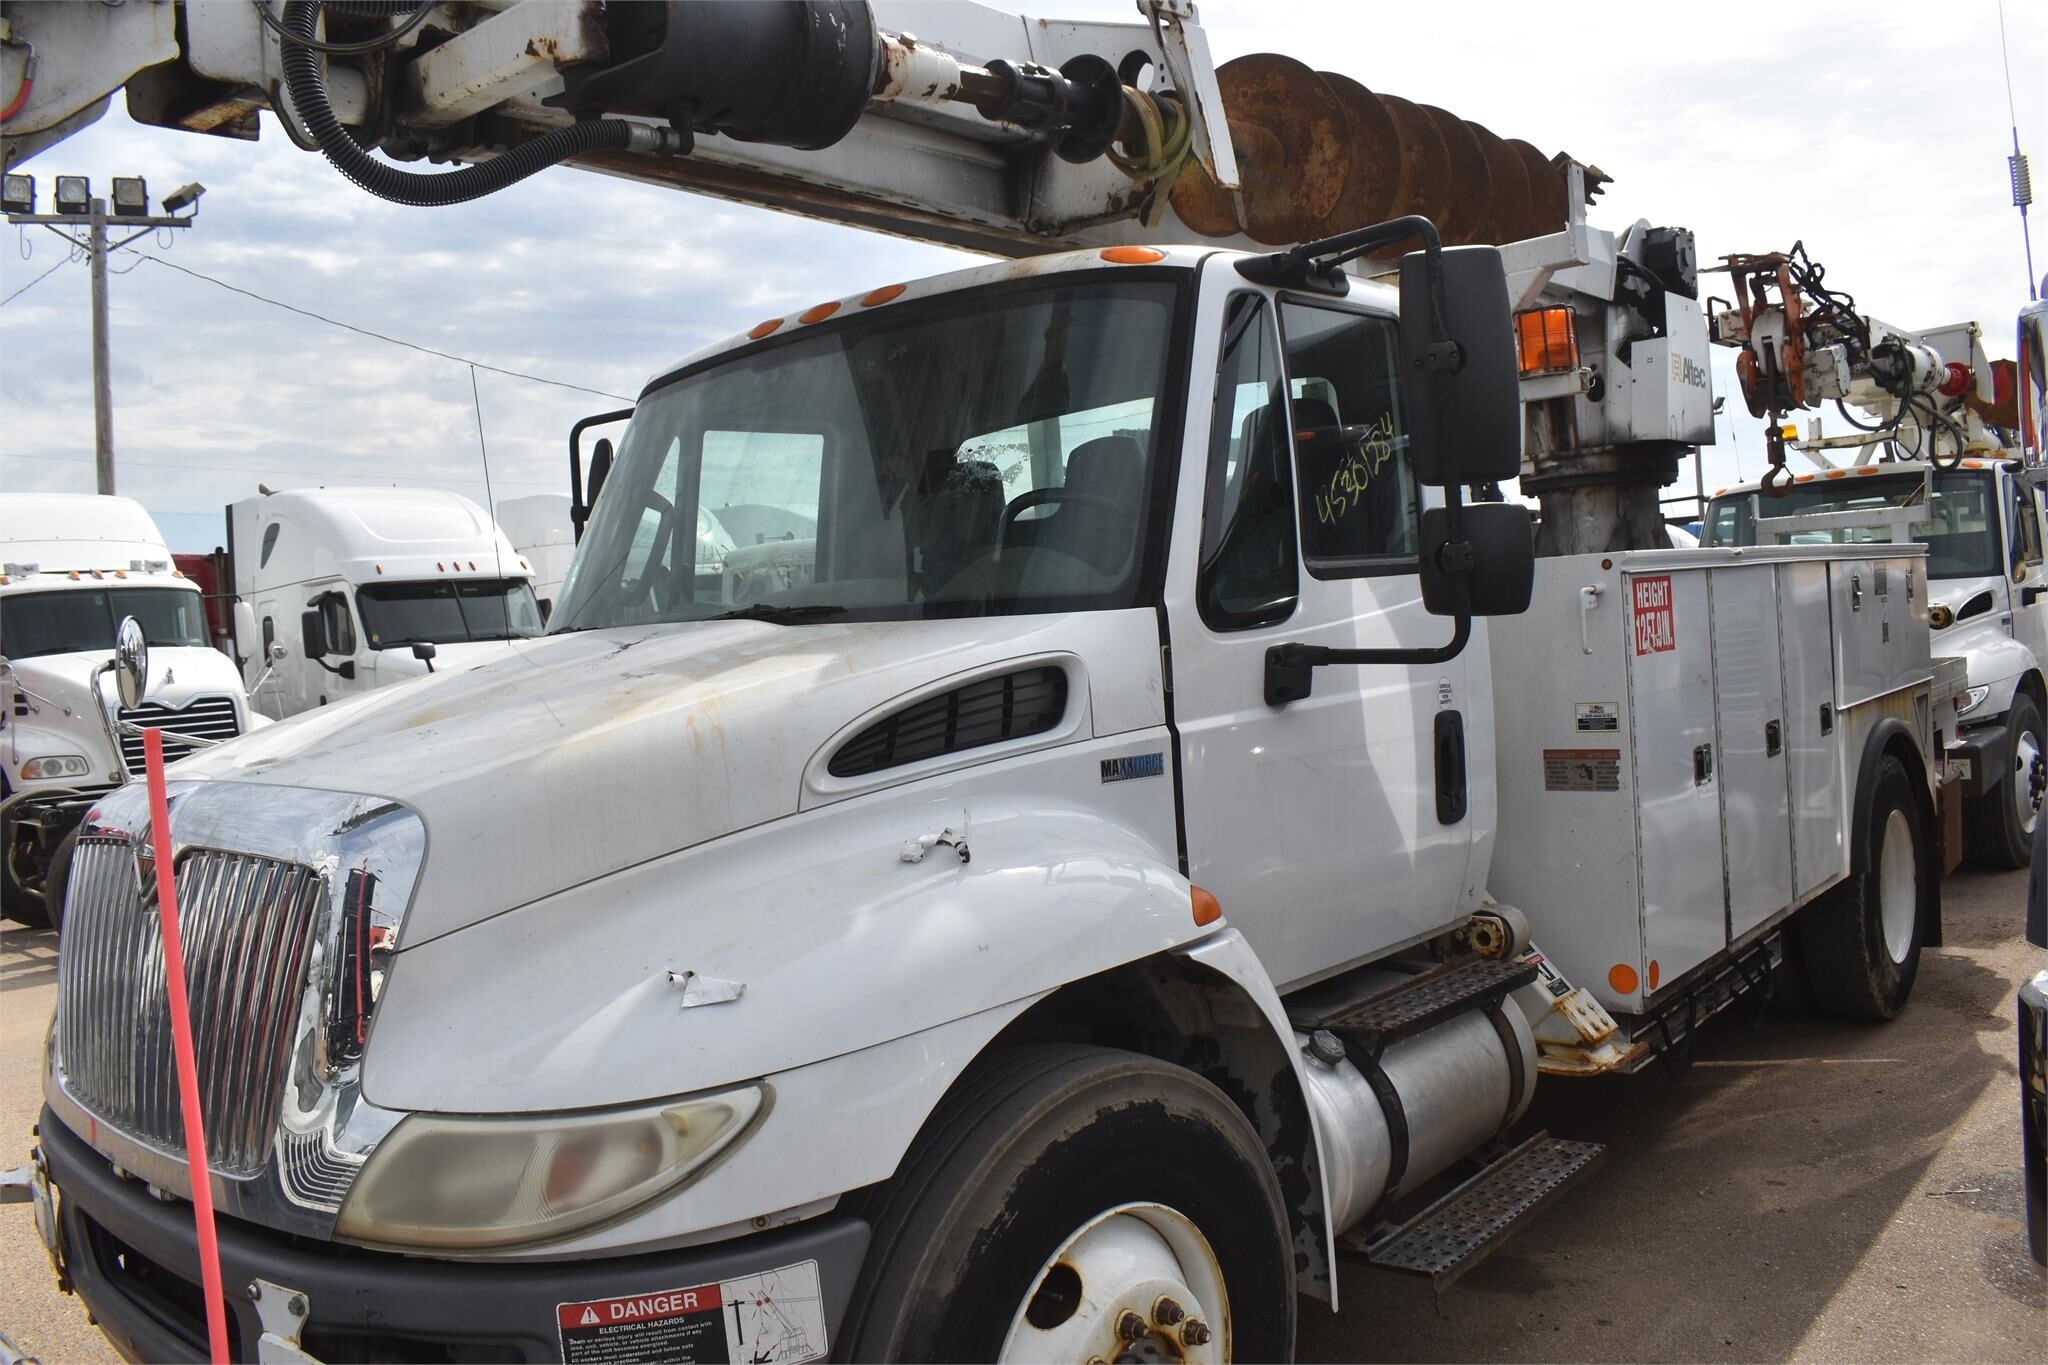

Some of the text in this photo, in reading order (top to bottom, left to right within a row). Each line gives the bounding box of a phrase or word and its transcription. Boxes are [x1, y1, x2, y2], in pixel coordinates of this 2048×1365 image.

[1682, 357, 1706, 388] Altec
[1636, 581, 1669, 608] HEIGHT
[610, 1292, 699, 1319] DANGER
[599, 1317, 685, 1335] ELECTRICAL HAZARDS
